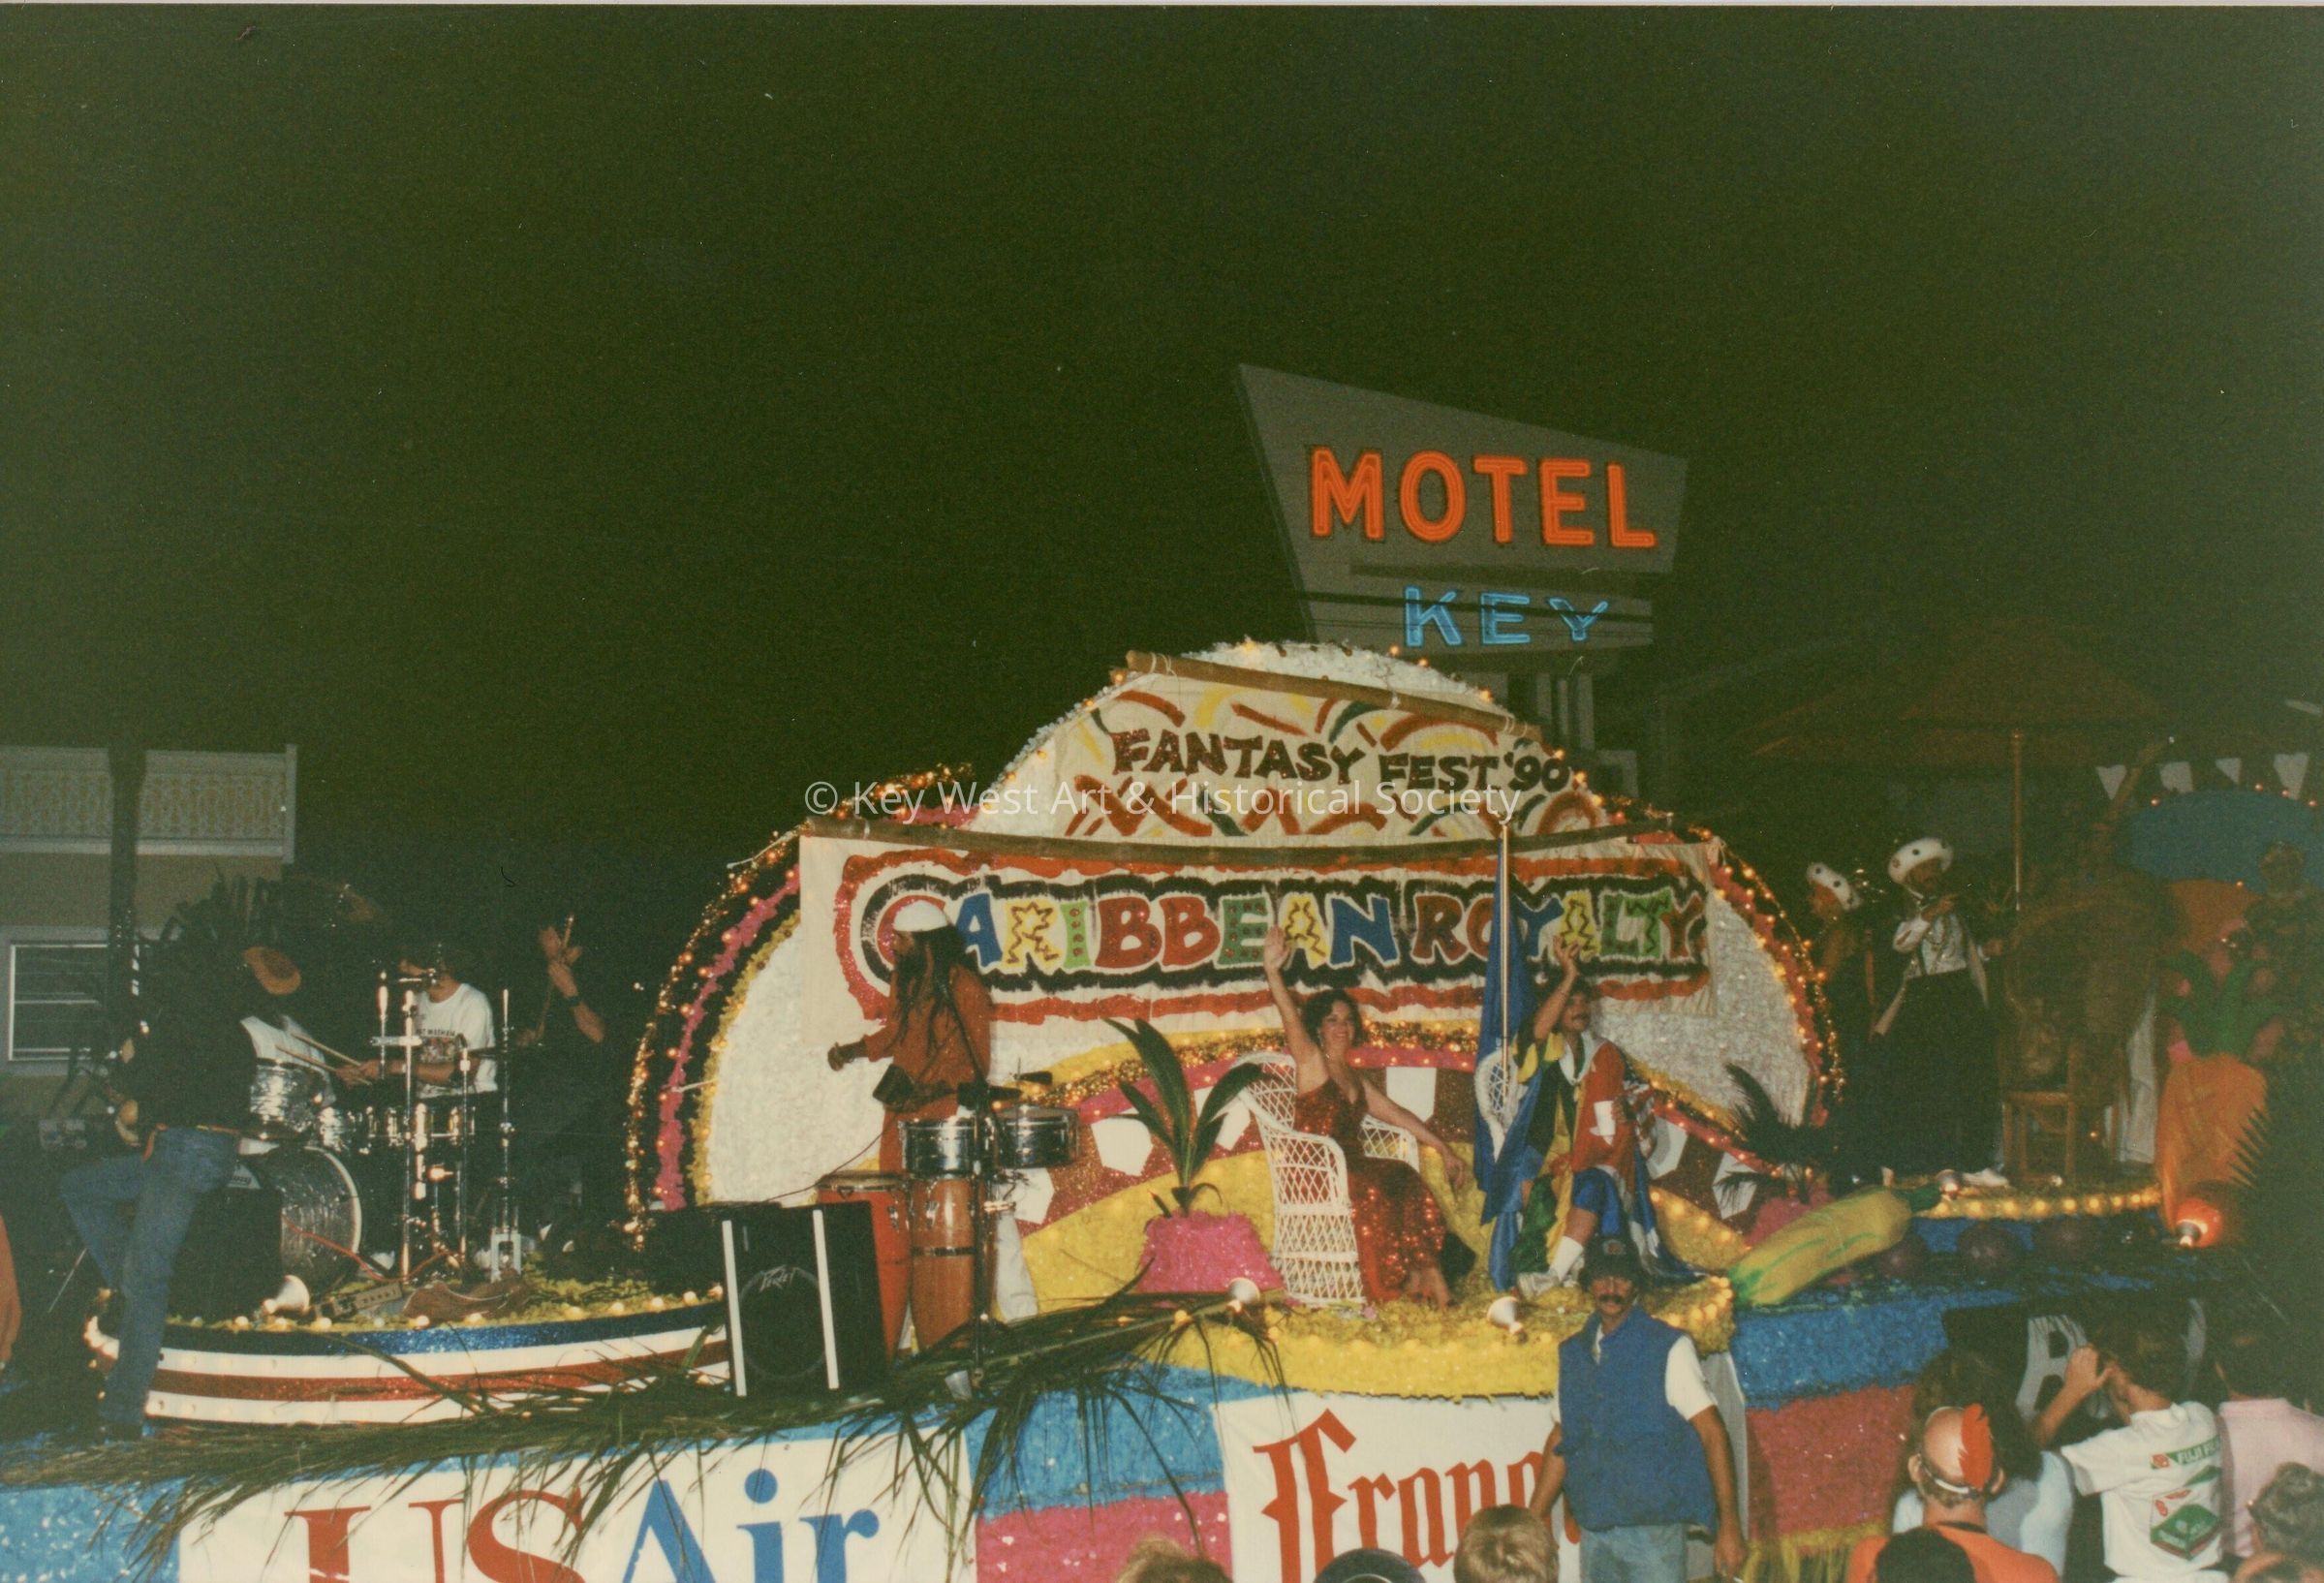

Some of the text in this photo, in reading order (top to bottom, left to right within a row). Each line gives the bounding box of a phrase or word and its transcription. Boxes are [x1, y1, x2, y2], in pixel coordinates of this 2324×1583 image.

[1311, 446, 1658, 547] MOTEL
[1404, 586, 1610, 647] KEY
[1112, 729, 1570, 793] FANTASY FEST '90
